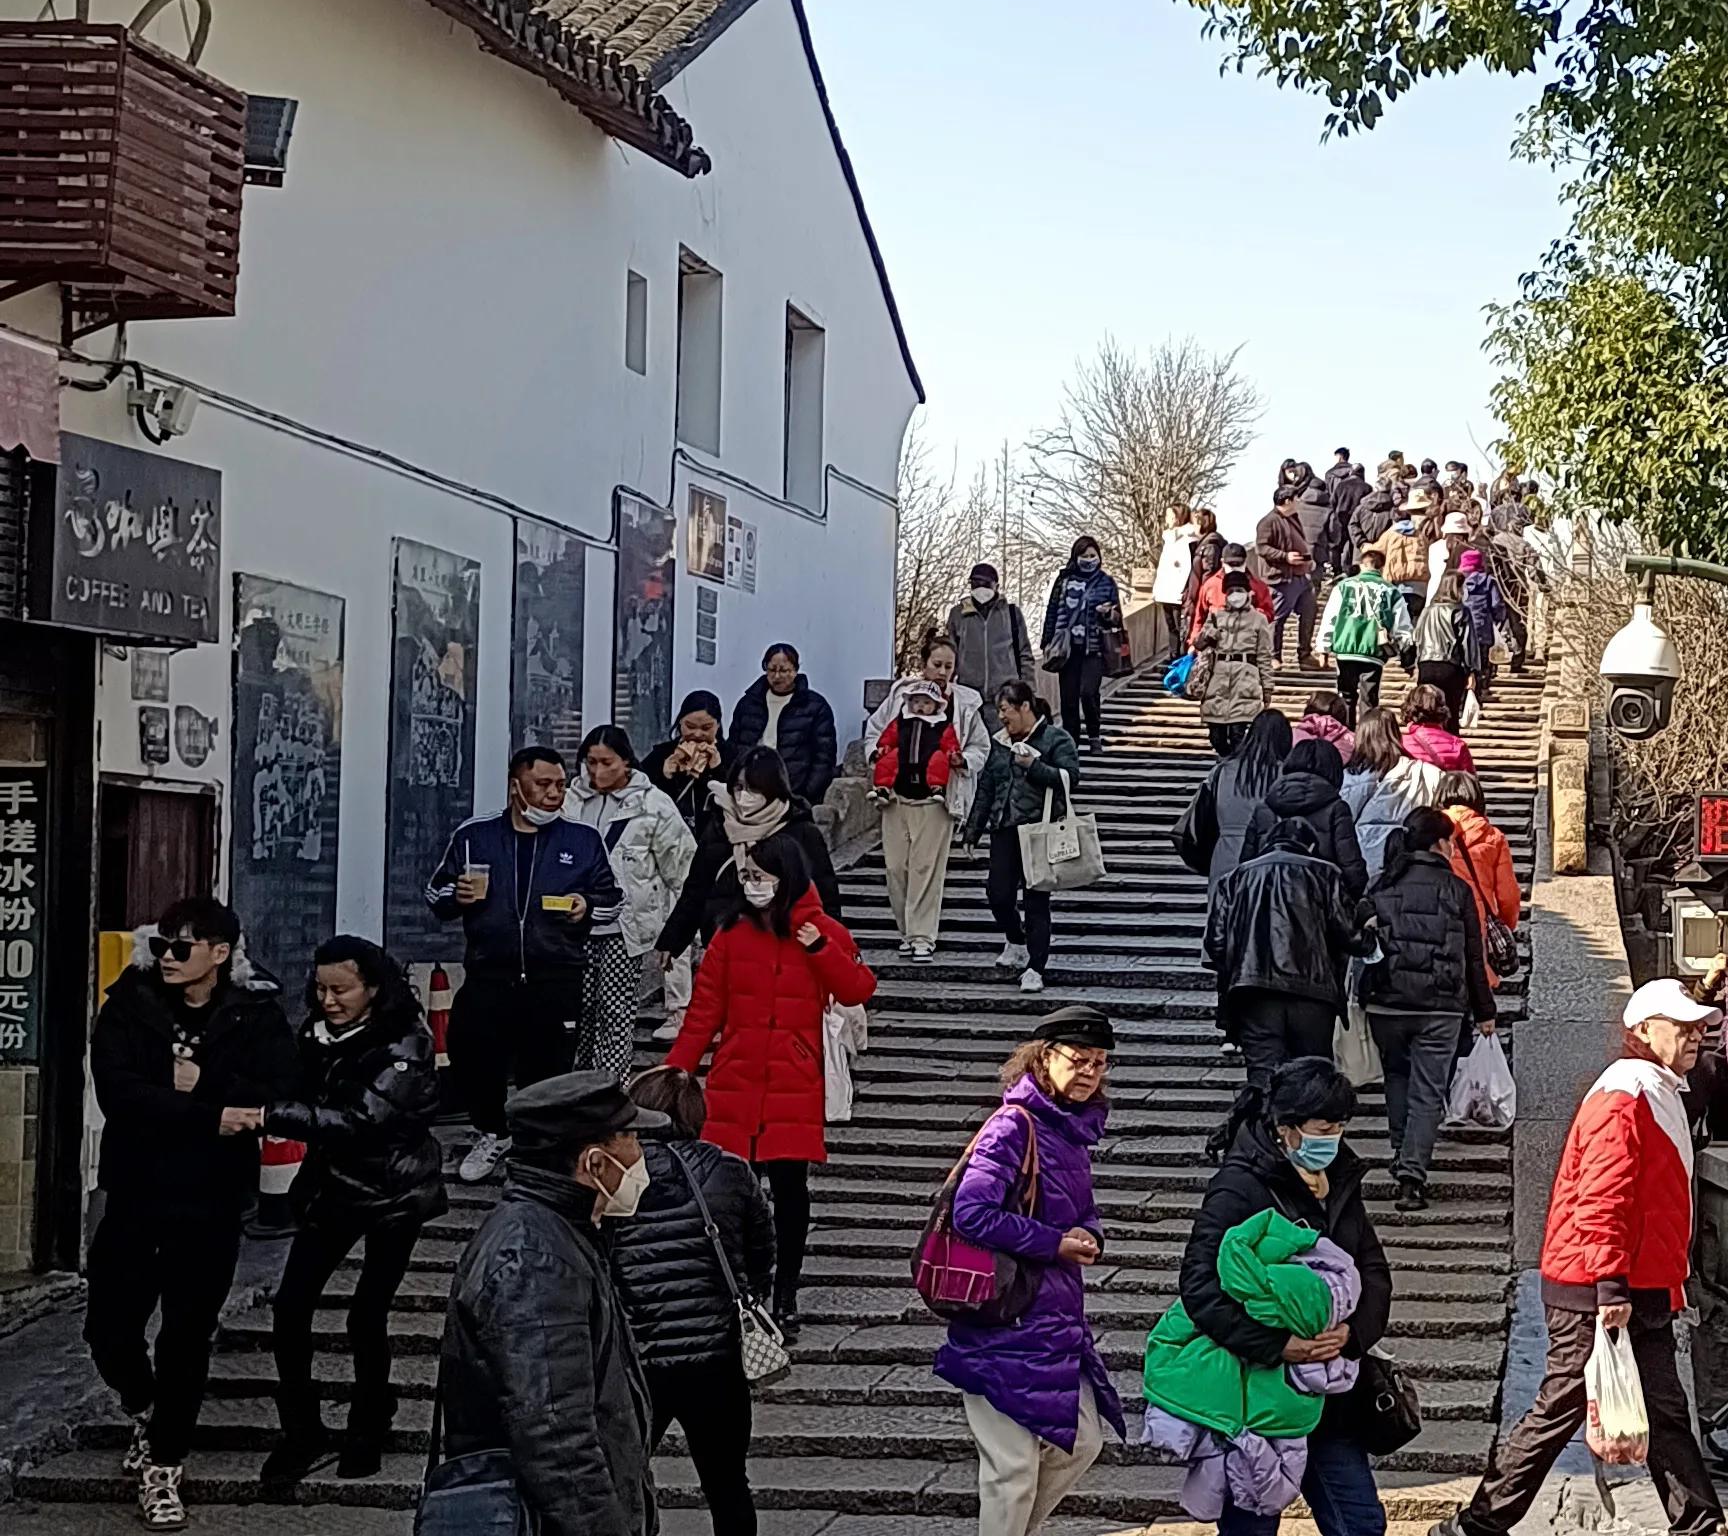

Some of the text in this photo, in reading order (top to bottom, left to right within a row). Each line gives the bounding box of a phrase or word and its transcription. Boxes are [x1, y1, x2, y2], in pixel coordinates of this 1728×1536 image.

[65, 575, 210, 625] COFFEE AND TEA
